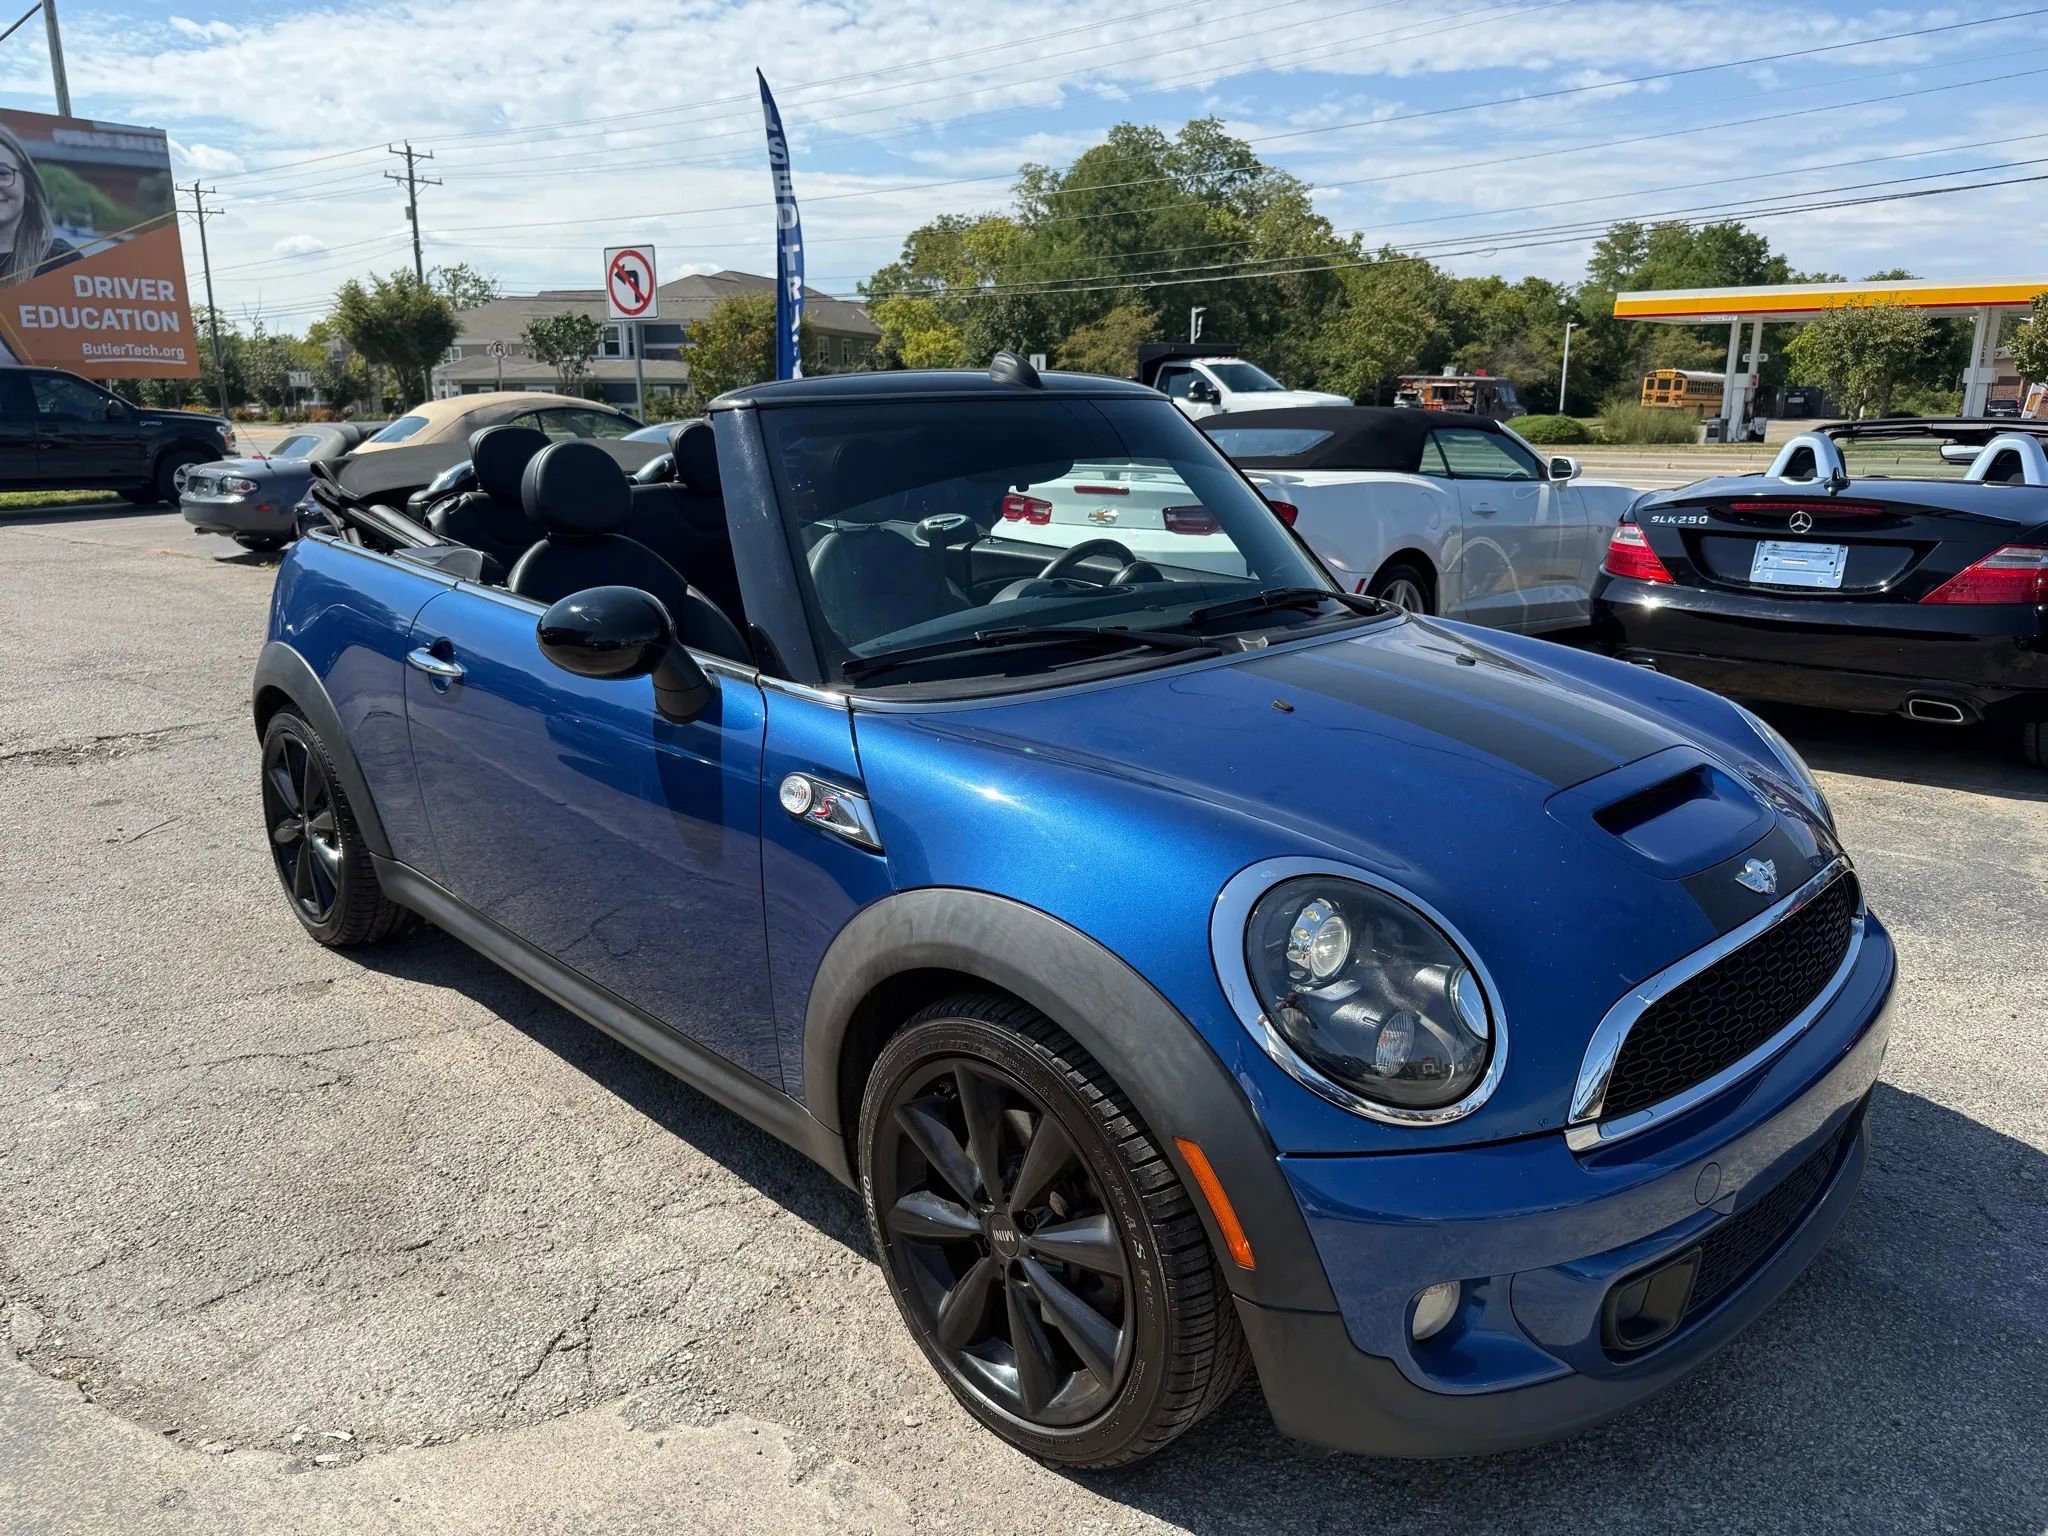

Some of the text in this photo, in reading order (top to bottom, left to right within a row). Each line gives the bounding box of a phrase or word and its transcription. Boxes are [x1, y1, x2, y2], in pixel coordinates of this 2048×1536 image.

[74, 275, 175, 301] DRIVER
[19, 305, 180, 332] EDUCATION
[82, 343, 185, 359] ButlerTech.org
[992, 1229, 1015, 1242] MINI
